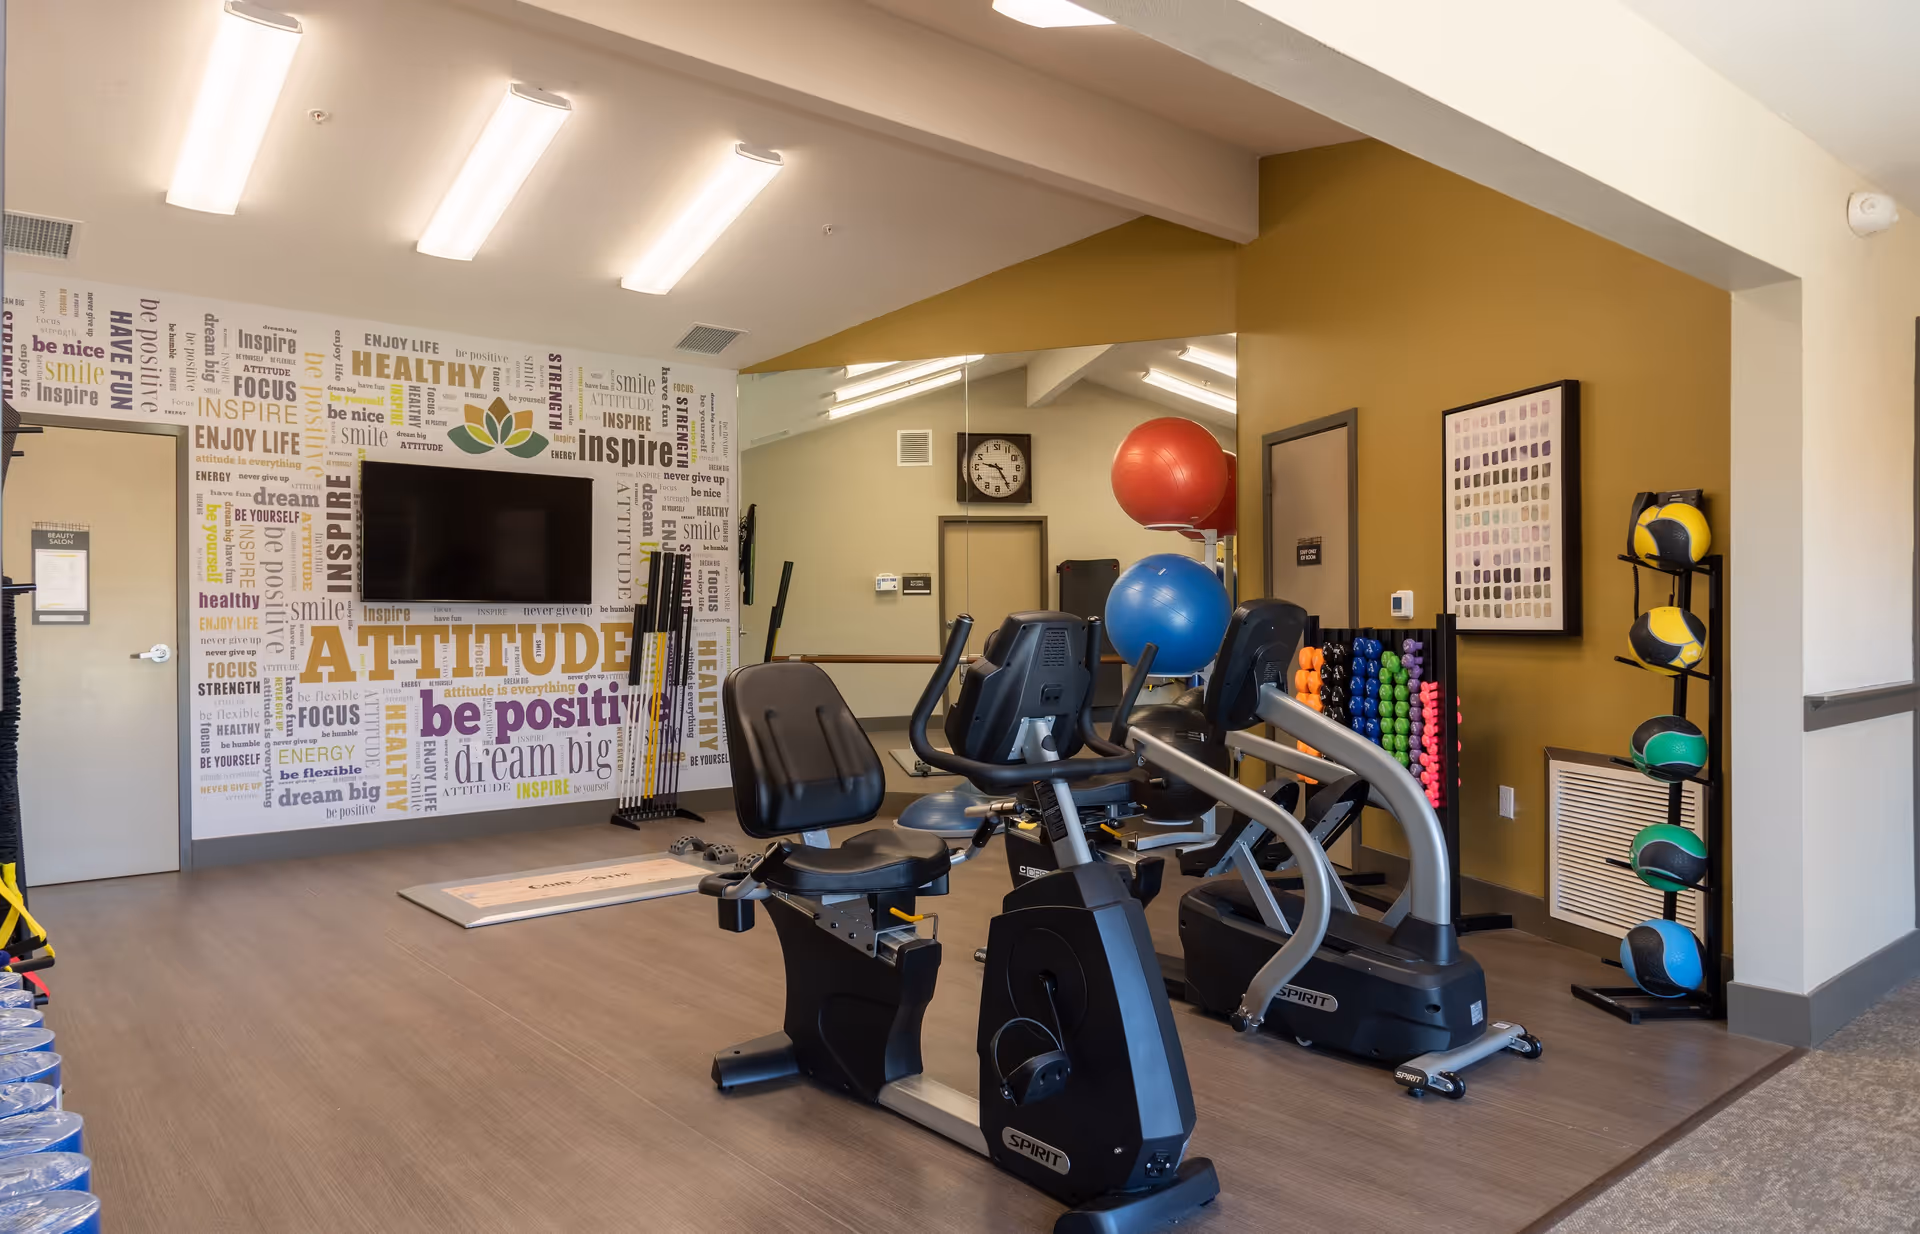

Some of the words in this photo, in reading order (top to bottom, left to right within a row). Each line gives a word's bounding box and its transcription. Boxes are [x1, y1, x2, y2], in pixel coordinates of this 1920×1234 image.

[140, 298, 160, 323] be
[110, 310, 133, 364] HAVE
[184, 332, 197, 346] be
[204, 313, 220, 356] dream
[238, 329, 297, 355] Inspire
[333, 329, 344, 362] enjoy
[364, 333, 408, 350] ENJOY
[412, 340, 440, 354] LIFE
[32, 334, 58, 354] be
[62, 340, 105, 359] nice
[455, 349, 467, 358] be
[470, 350, 509, 364] positive
[45, 360, 105, 386] smile
[135, 328, 162, 413] positive
[184, 347, 198, 392] positive
[201, 359, 220, 384] big
[243, 364, 291, 377] ATTITUDE
[304, 352, 326, 378] be
[335, 363, 344, 382] life
[351, 350, 488, 390] HEALTHY
[524, 355, 536, 392] smile
[37, 382, 99, 406] Inspire
[110, 370, 133, 410] FUN
[233, 375, 297, 402] FOCUS
[549, 353, 562, 430] STRENGTH
[616, 373, 656, 395] smile
[661, 367, 671, 401] have
[673, 383, 694, 393] FOCUS
[198, 396, 298, 425] INSPIRE
[327, 404, 347, 420] be
[351, 407, 385, 423] nice
[390, 383, 404, 426] INSPIRE
[408, 385, 422, 429] HEALTHY
[661, 404, 671, 428] fun
[300, 386, 328, 478] positive
[602, 412, 651, 432] INSPIRE
[676, 396, 688, 468] STRENGTH
[195, 425, 257, 452] ENJOY
[262, 430, 301, 456] LIFE
[341, 425, 388, 447] smile
[400, 441, 443, 452] ATTITUDE
[551, 450, 576, 461] ENERGY
[579, 429, 673, 468] inspire
[196, 455, 236, 465] attitude
[238, 457, 247, 465] is
[248, 458, 302, 470] everything
[196, 471, 231, 482] ENERGY
[238, 472, 260, 481] never
[262, 473, 278, 482] give
[279, 475, 290, 483] up
[664, 472, 689, 481] never
[691, 474, 711, 483] give
[713, 475, 725, 485] up
[253, 487, 320, 508] dream
[691, 487, 701, 497] be
[703, 488, 721, 498] nice
[206, 504, 222, 521] be
[224, 501, 234, 527] dream
[235, 509, 247, 521] BE
[249, 509, 300, 524] YOURSELF
[642, 483, 657, 537] dream
[697, 505, 729, 517] HEALTHY
[223, 529, 234, 543] big
[264, 527, 286, 553] be
[326, 474, 352, 593] INSPIRE
[617, 482, 631, 600] ATTITUDE
[684, 520, 720, 541] smile
[202, 524, 223, 584] yourself
[225, 544, 235, 566] have
[239, 524, 255, 588] INSPIRE
[301, 512, 312, 591] ATTITUDE
[226, 569, 236, 584] fun
[199, 592, 260, 610] healthy
[260, 561, 289, 654] positive
[291, 597, 345, 621] smile
[477, 608, 507, 616] INSPIRE
[523, 606, 553, 616] never
[555, 606, 578, 618] give
[580, 607, 593, 617] up
[610, 605, 634, 613] humble
[199, 617, 234, 631] ENJOY
[236, 617, 258, 630] LIFE
[363, 605, 411, 624] Inspire
[200, 637, 226, 645] never
[229, 637, 247, 646] give
[249, 637, 262, 645] up
[229, 649, 246, 657] give
[247, 649, 257, 657] up
[299, 622, 633, 684] ATTITUDE
[207, 661, 257, 679] FOCUS
[475, 644, 484, 677] FOCUS
[198, 681, 261, 696] STRENGTH
[285, 676, 296, 710] have
[444, 684, 494, 698] attitude
[497, 685, 508, 696] is
[510, 681, 576, 697] everything
[698, 640, 718, 751] HEALTHY
[264, 677, 272, 725] attitude
[298, 704, 360, 728] FOCUS
[420, 689, 481, 737] be
[495, 681, 671, 745] positive
[216, 722, 261, 736] HEALTHY
[264, 728, 273, 739] is
[286, 714, 296, 737] fun
[321, 730, 330, 738] be
[332, 729, 358, 737] humble
[221, 741, 230, 749] be
[232, 740, 261, 748] humble
[279, 745, 355, 765] ENERGY
[200, 757, 211, 769] BE
[214, 753, 261, 768] YOURSELF
[385, 704, 409, 812] HEALTHY
[424, 740, 436, 781] ENJOY
[454, 744, 558, 784] dream
[566, 732, 612, 780] big
[262, 741, 275, 808] everything
[280, 770, 299, 780] be
[303, 765, 362, 779] flexible
[278, 788, 343, 807] dream
[349, 782, 381, 803] big
[424, 785, 437, 812] LIFE
[442, 782, 511, 797] ATTITUDE
[517, 778, 570, 799] INSPIRE
[573, 785, 582, 793] be
[583, 782, 610, 794] yourself
[326, 807, 337, 819] be
[339, 803, 376, 820] positive
[1276, 986, 1330, 1008] SPIRIT
[1395, 1071, 1422, 1083] SPIRIT
[1009, 1133, 1062, 1167] SPIRIT
